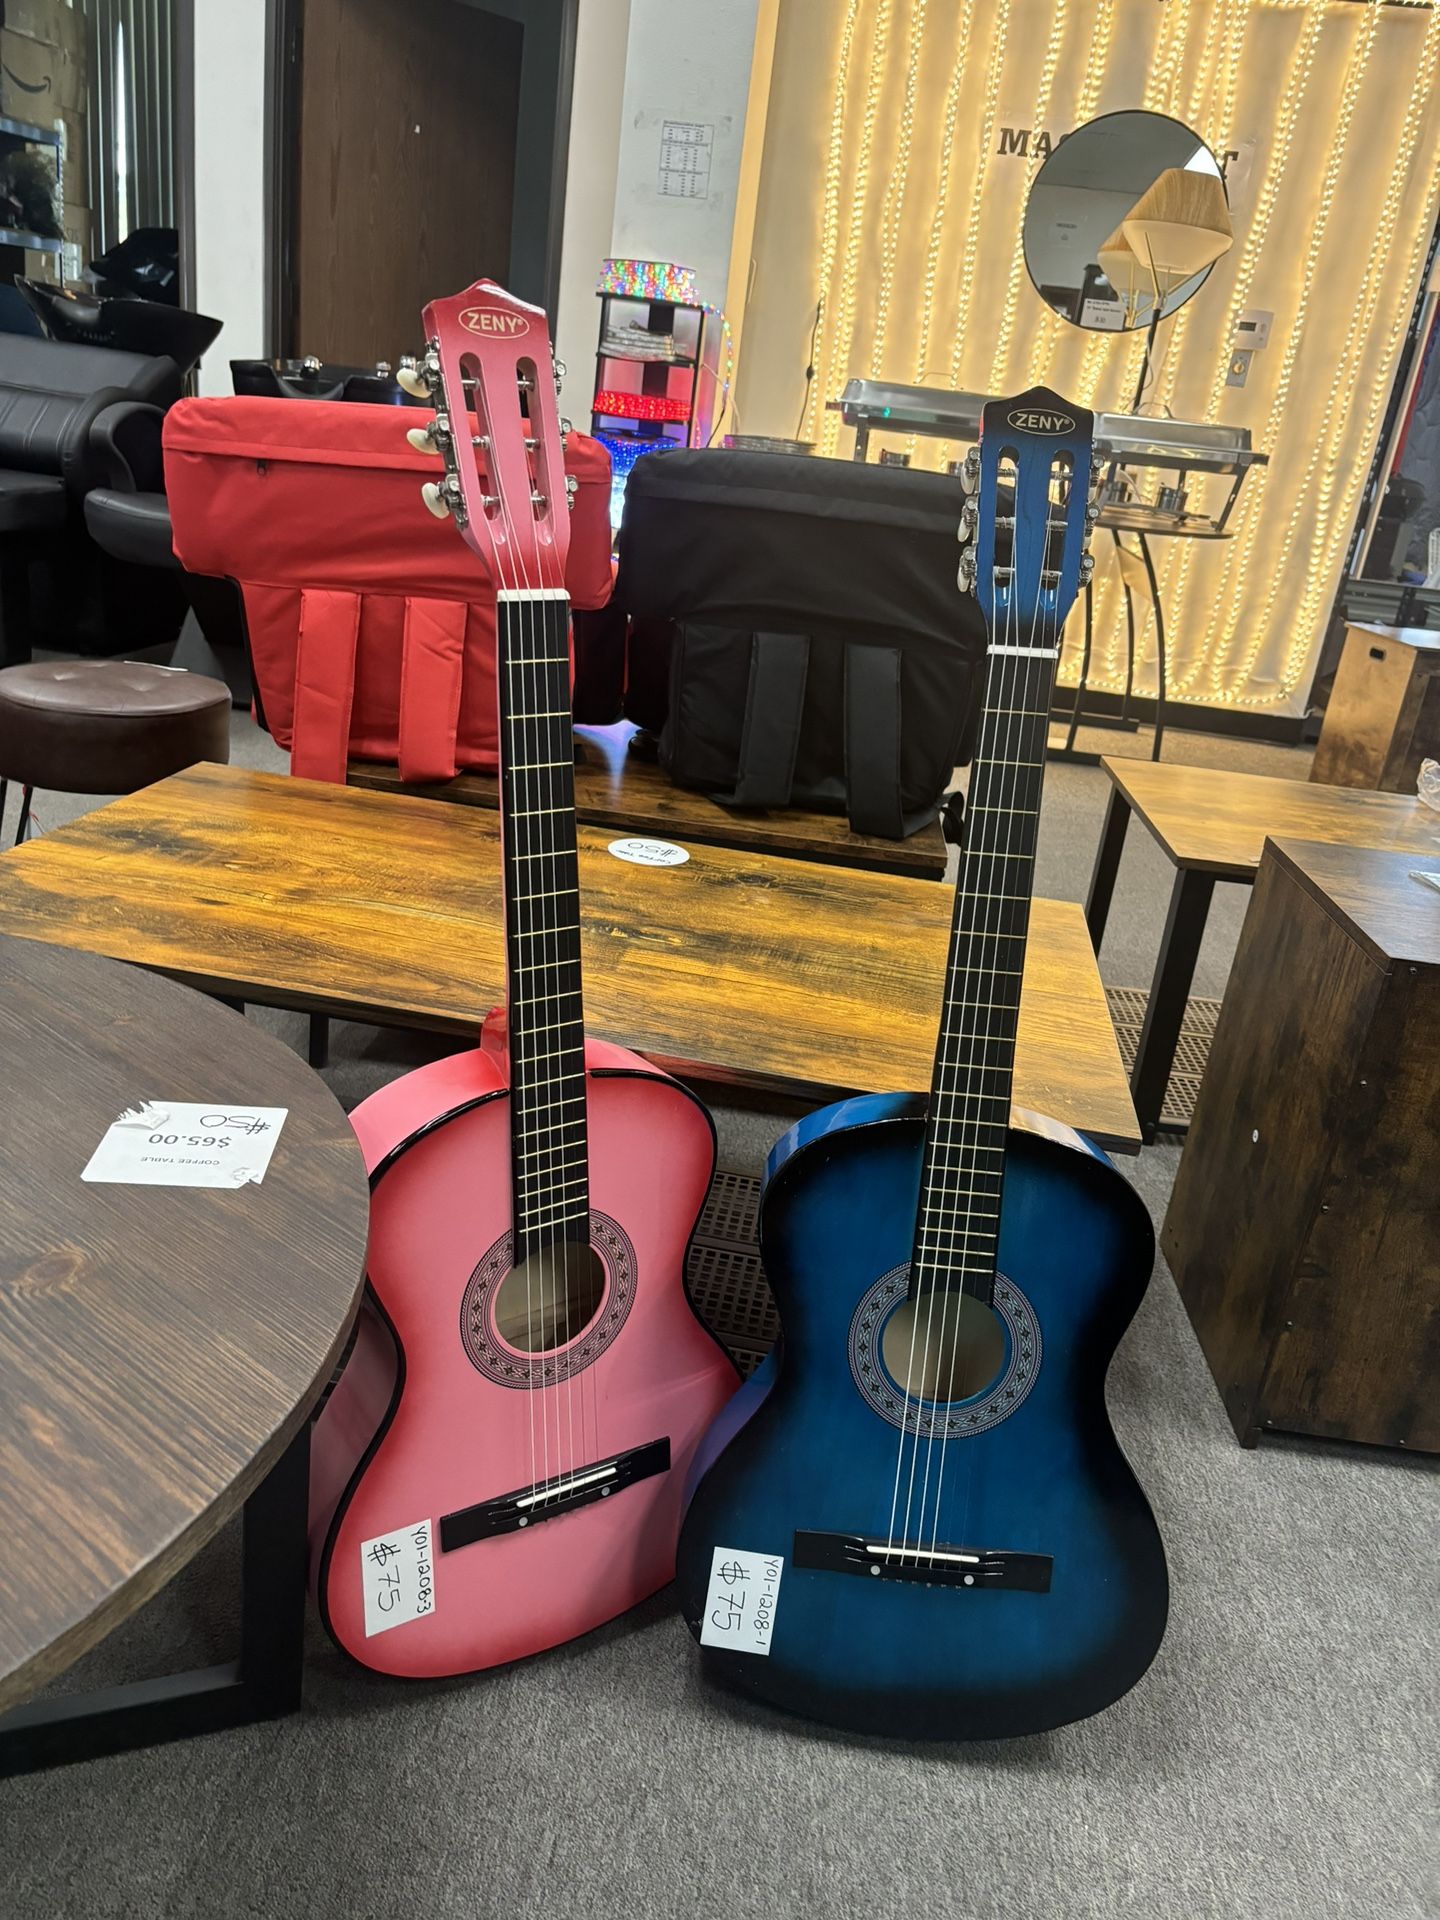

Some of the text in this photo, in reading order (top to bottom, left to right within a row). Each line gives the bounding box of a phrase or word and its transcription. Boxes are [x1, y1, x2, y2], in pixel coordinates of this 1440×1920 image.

[466, 312, 517, 333] ZENY
[1015, 412, 1064, 431] ZENY
[199, 1114, 272, 1136] $50
[148, 1133, 232, 1149] $65.00
[140, 1156, 220, 1166] COFFEE TABLE
[367, 1543, 401, 1612] $75
[711, 1560, 751, 1631] $75
